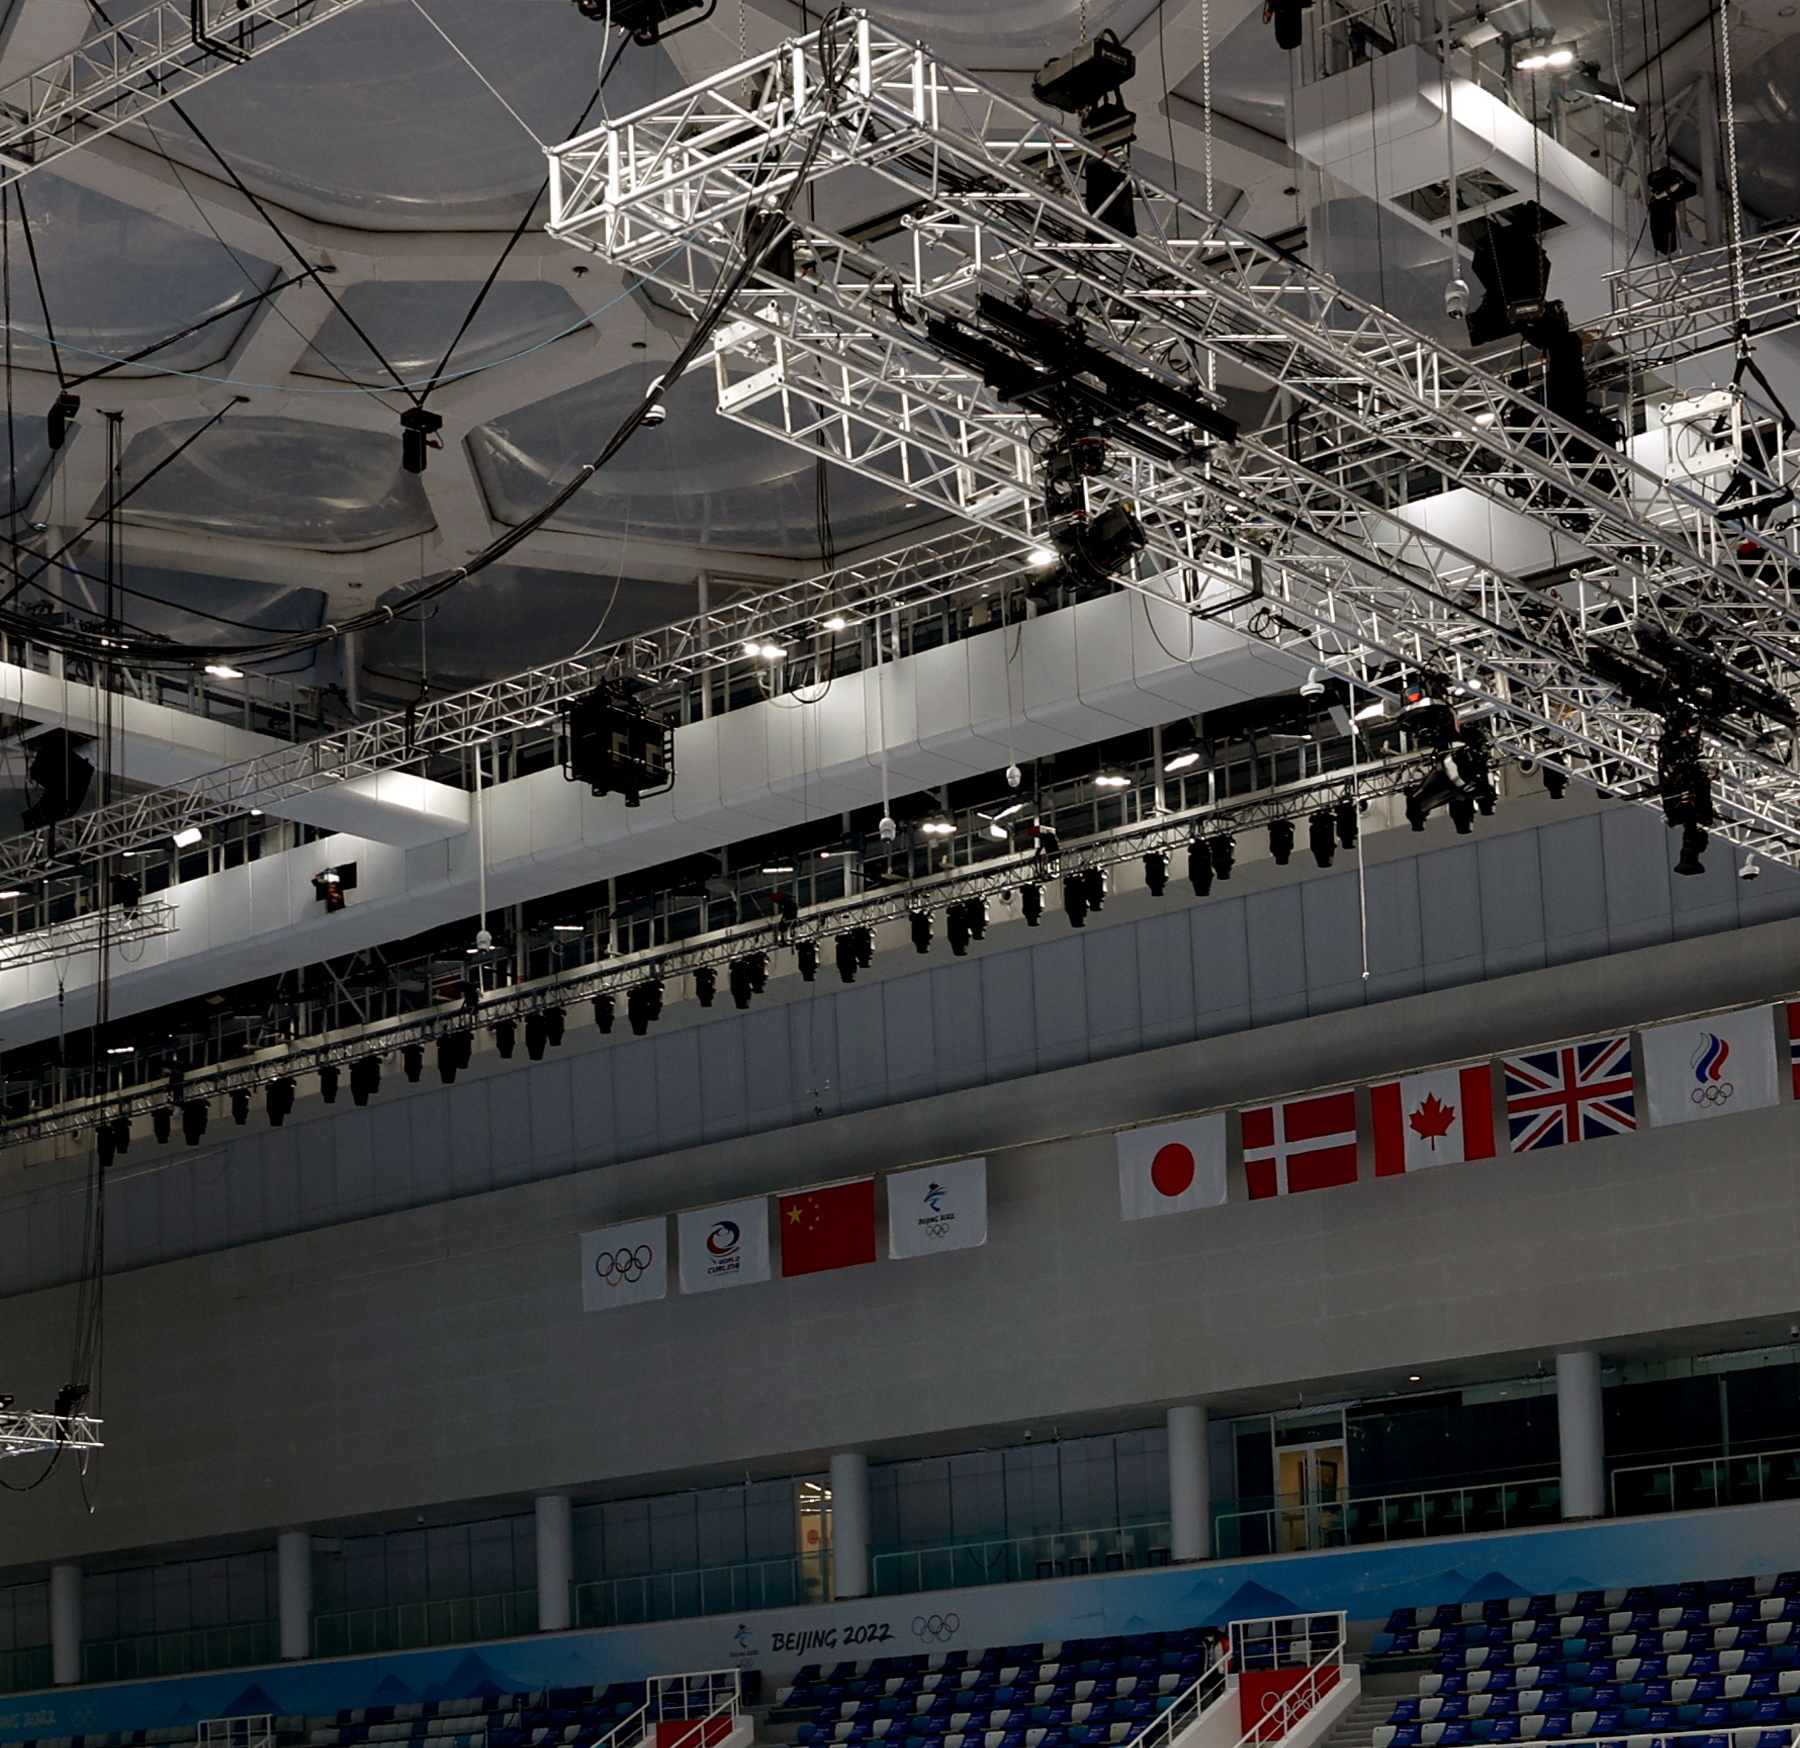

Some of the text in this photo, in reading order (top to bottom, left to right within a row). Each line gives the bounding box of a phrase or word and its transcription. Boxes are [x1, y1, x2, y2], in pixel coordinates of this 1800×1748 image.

[719, 1256, 740, 1264] WORLD
[708, 1262, 740, 1274] CURLING
[772, 1624, 894, 1657] BEIJING 2022
